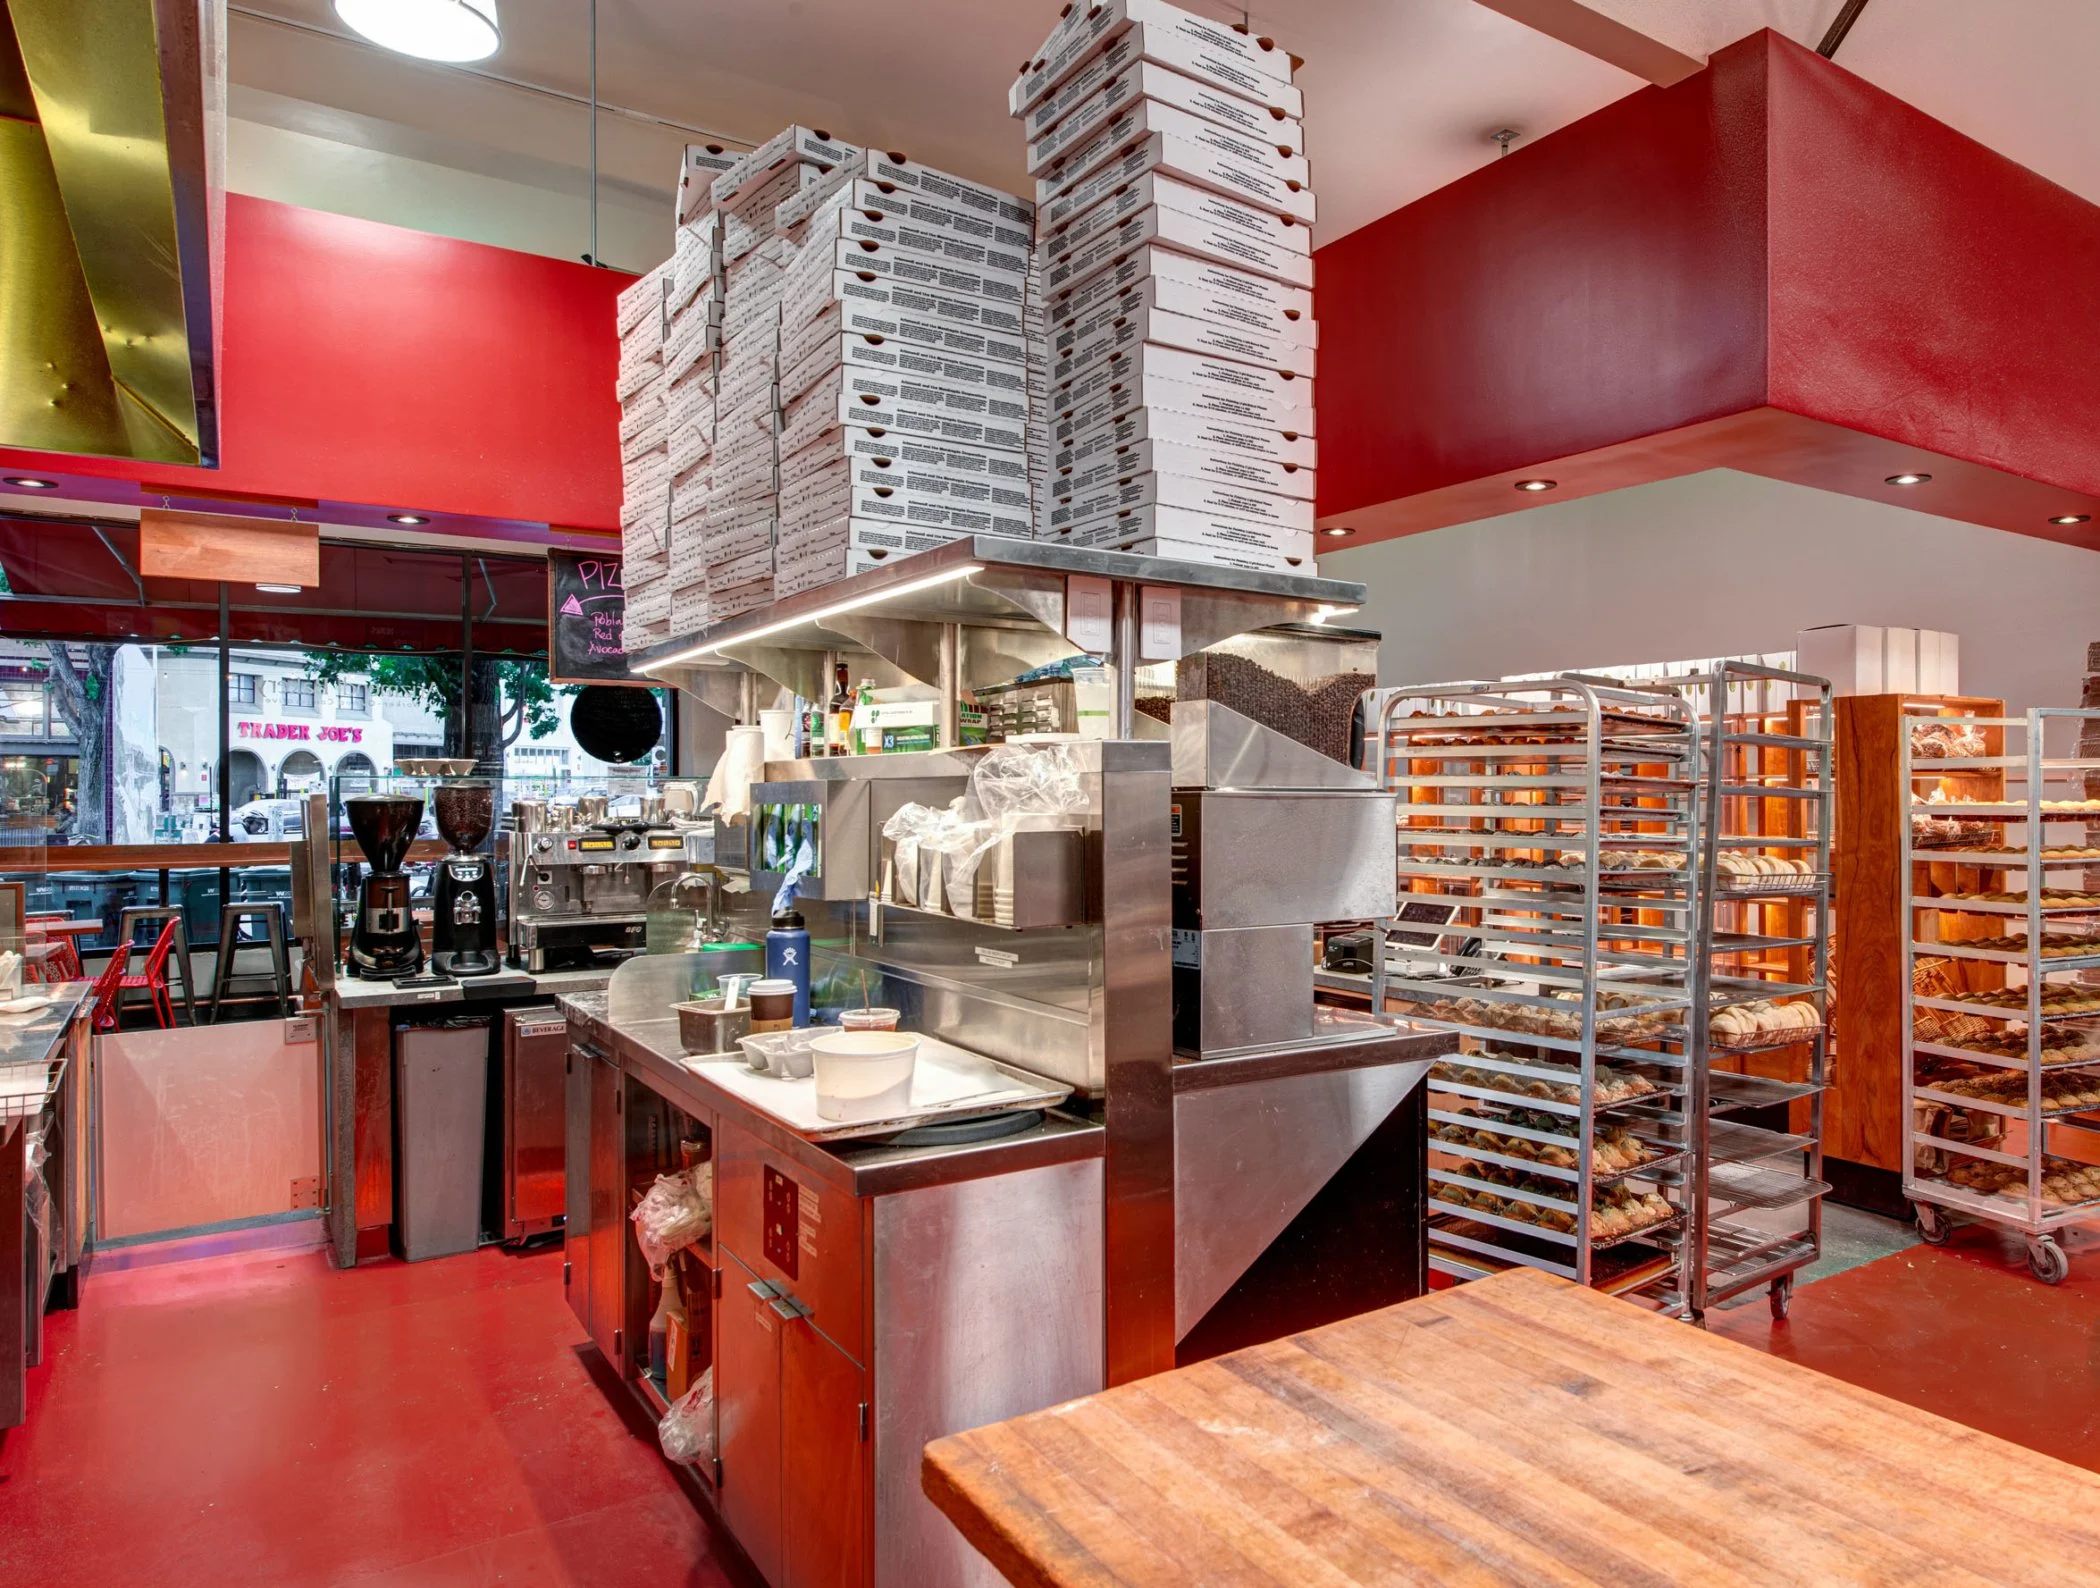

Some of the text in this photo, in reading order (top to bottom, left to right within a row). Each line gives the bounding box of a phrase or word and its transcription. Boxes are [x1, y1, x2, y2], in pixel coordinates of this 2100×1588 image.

[592, 628, 612, 640] Red
[238, 722, 364, 743] TRADER JOE'S
